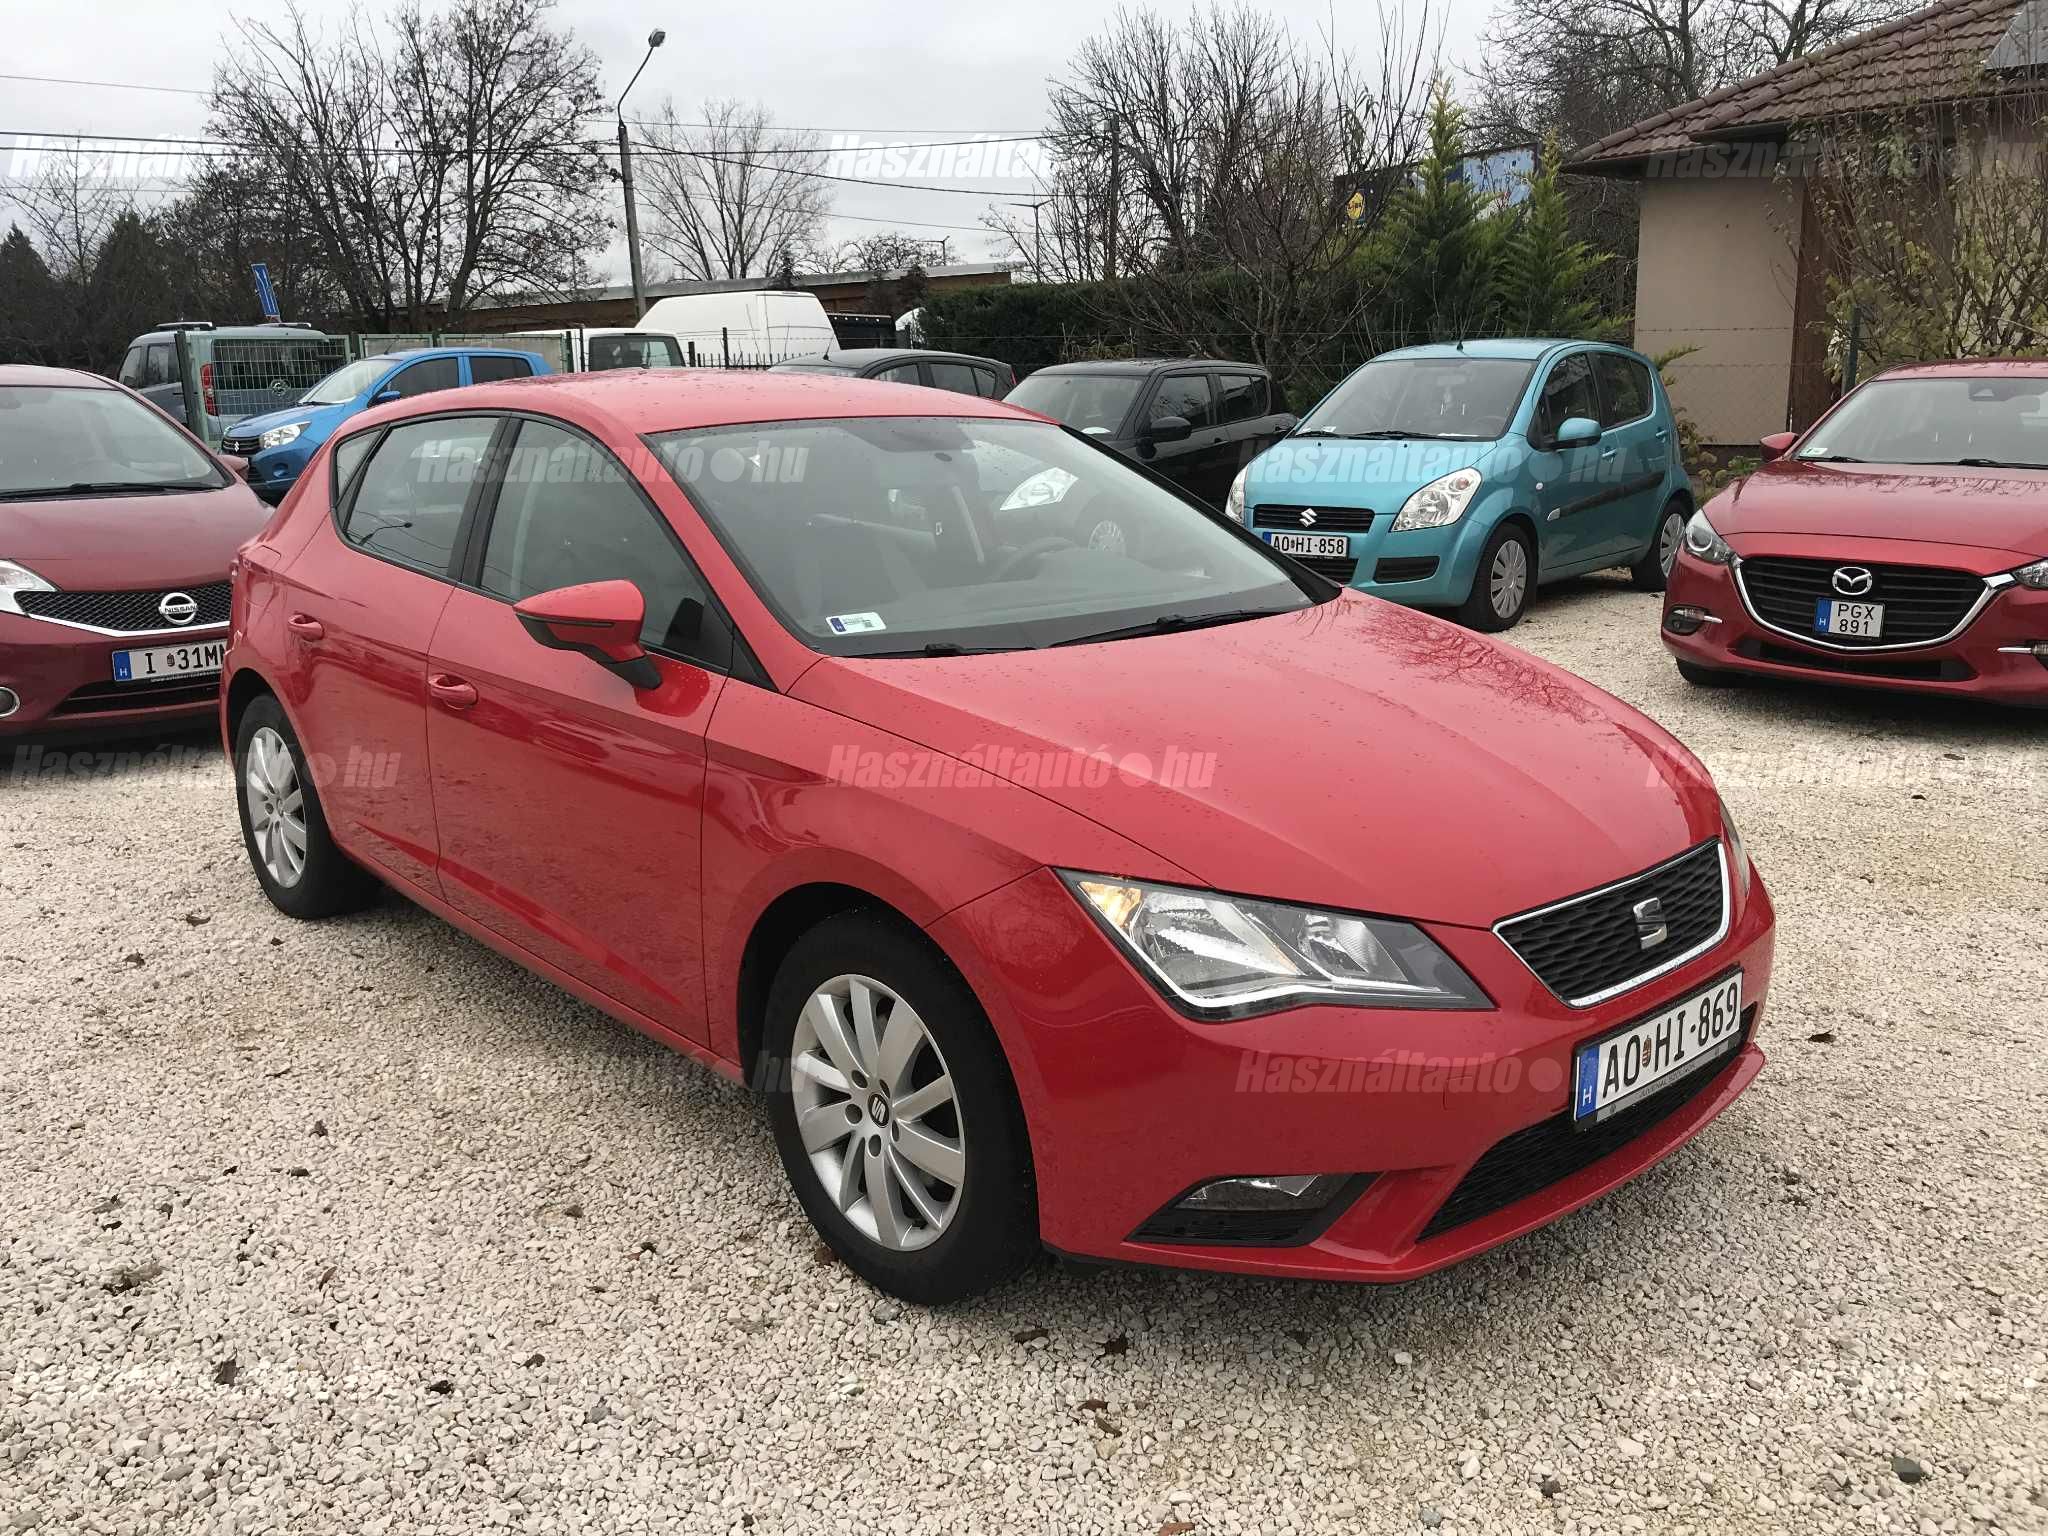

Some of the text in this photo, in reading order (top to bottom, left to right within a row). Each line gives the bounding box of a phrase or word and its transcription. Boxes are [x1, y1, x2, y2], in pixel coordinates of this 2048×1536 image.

[164, 604, 197, 613] NISSAN
[1838, 604, 1875, 620] PGX
[1839, 619, 1869, 634] 891
